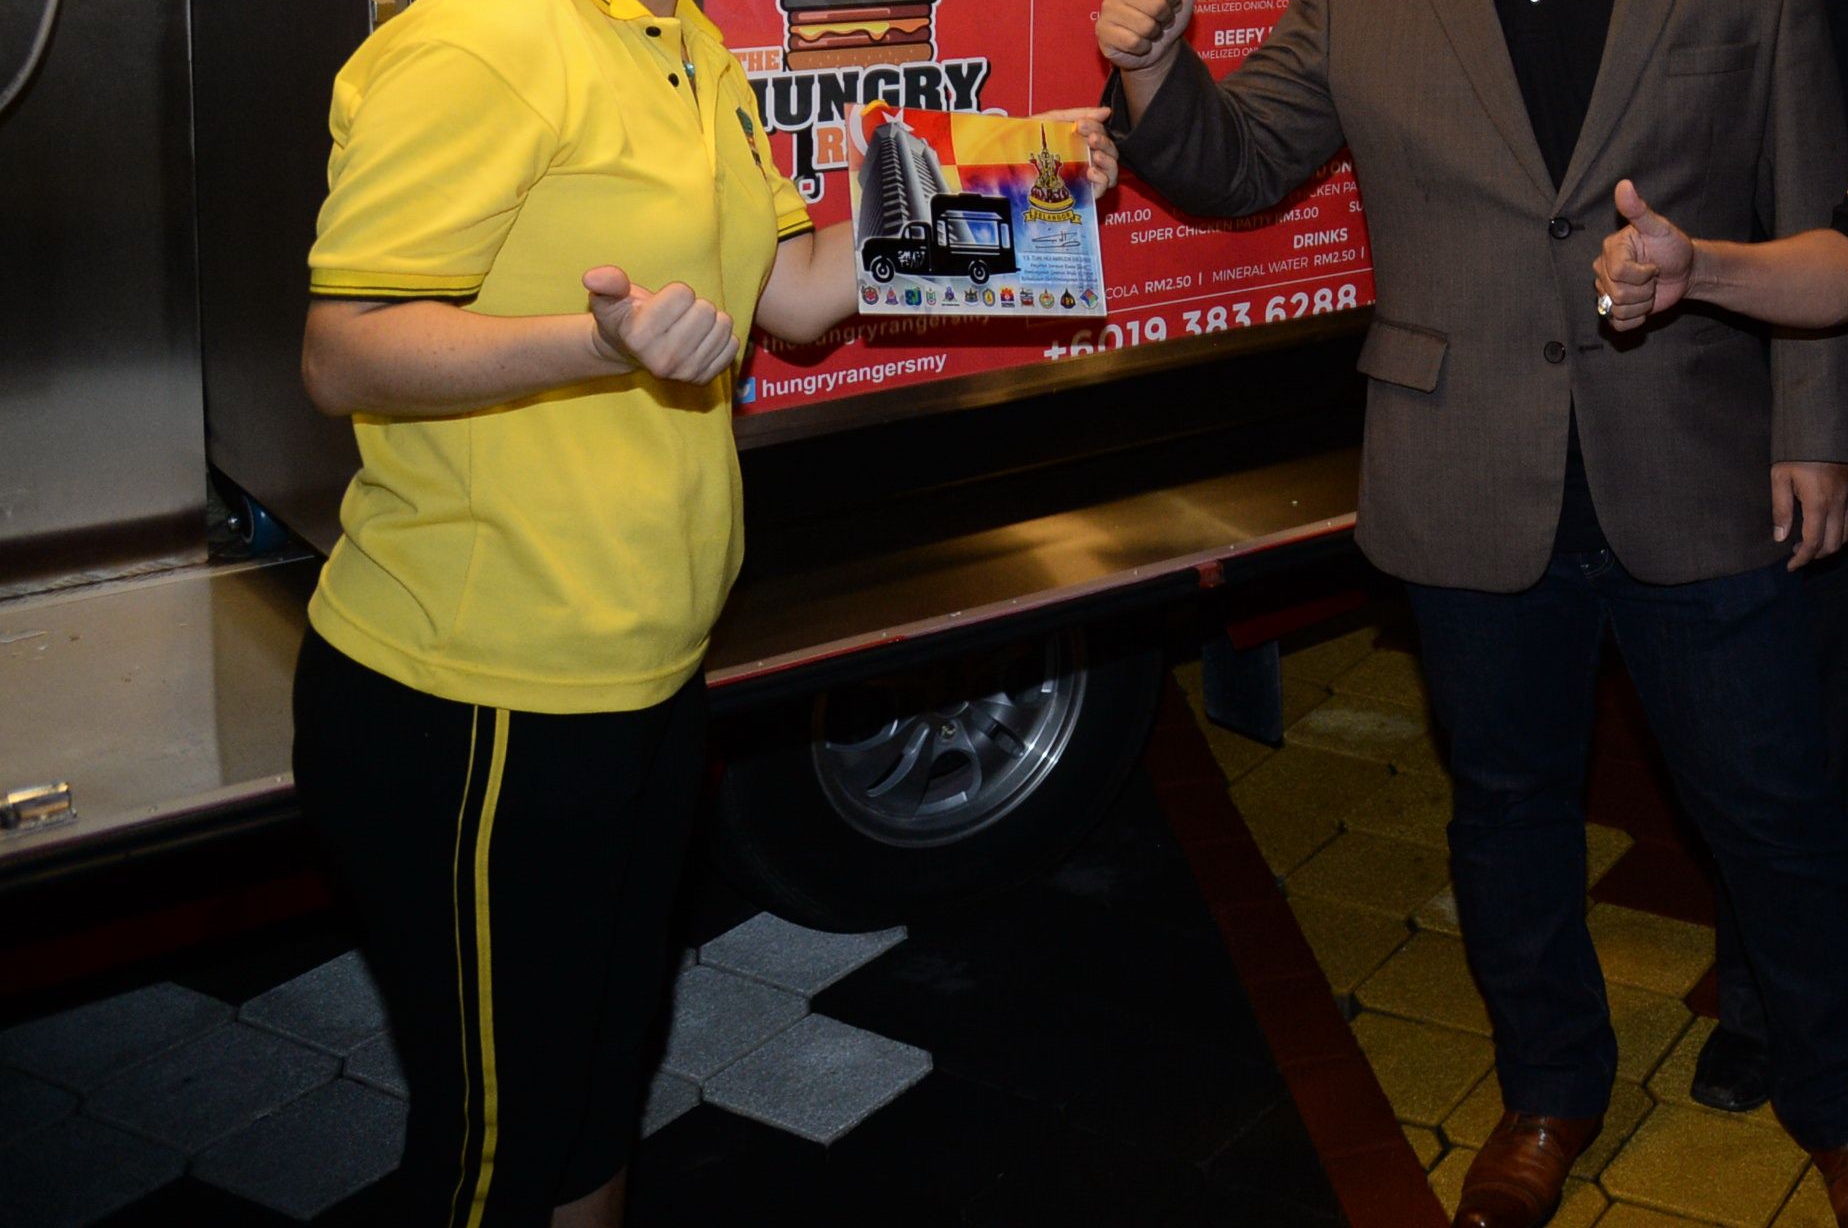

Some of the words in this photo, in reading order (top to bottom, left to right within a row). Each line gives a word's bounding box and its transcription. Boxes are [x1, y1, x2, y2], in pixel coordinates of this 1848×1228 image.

[1214, 26, 1265, 46] BEEFY
[1105, 208, 1151, 226] RM1.00
[1343, 181, 1358, 194] PA
[1130, 226, 1173, 244] SUPER
[1293, 227, 1348, 249] DRINKS
[1104, 283, 1138, 300] COLA
[1144, 274, 1192, 293] RM2.50
[1212, 264, 1266, 283] MINERAL
[1268, 257, 1309, 274] WATER
[1313, 248, 1356, 267] RM2.50
[1043, 316, 1167, 361] +6019
[1182, 301, 1252, 336] 383
[1264, 283, 1357, 325] 6288
[761, 353, 947, 398] hungryrangersmy
